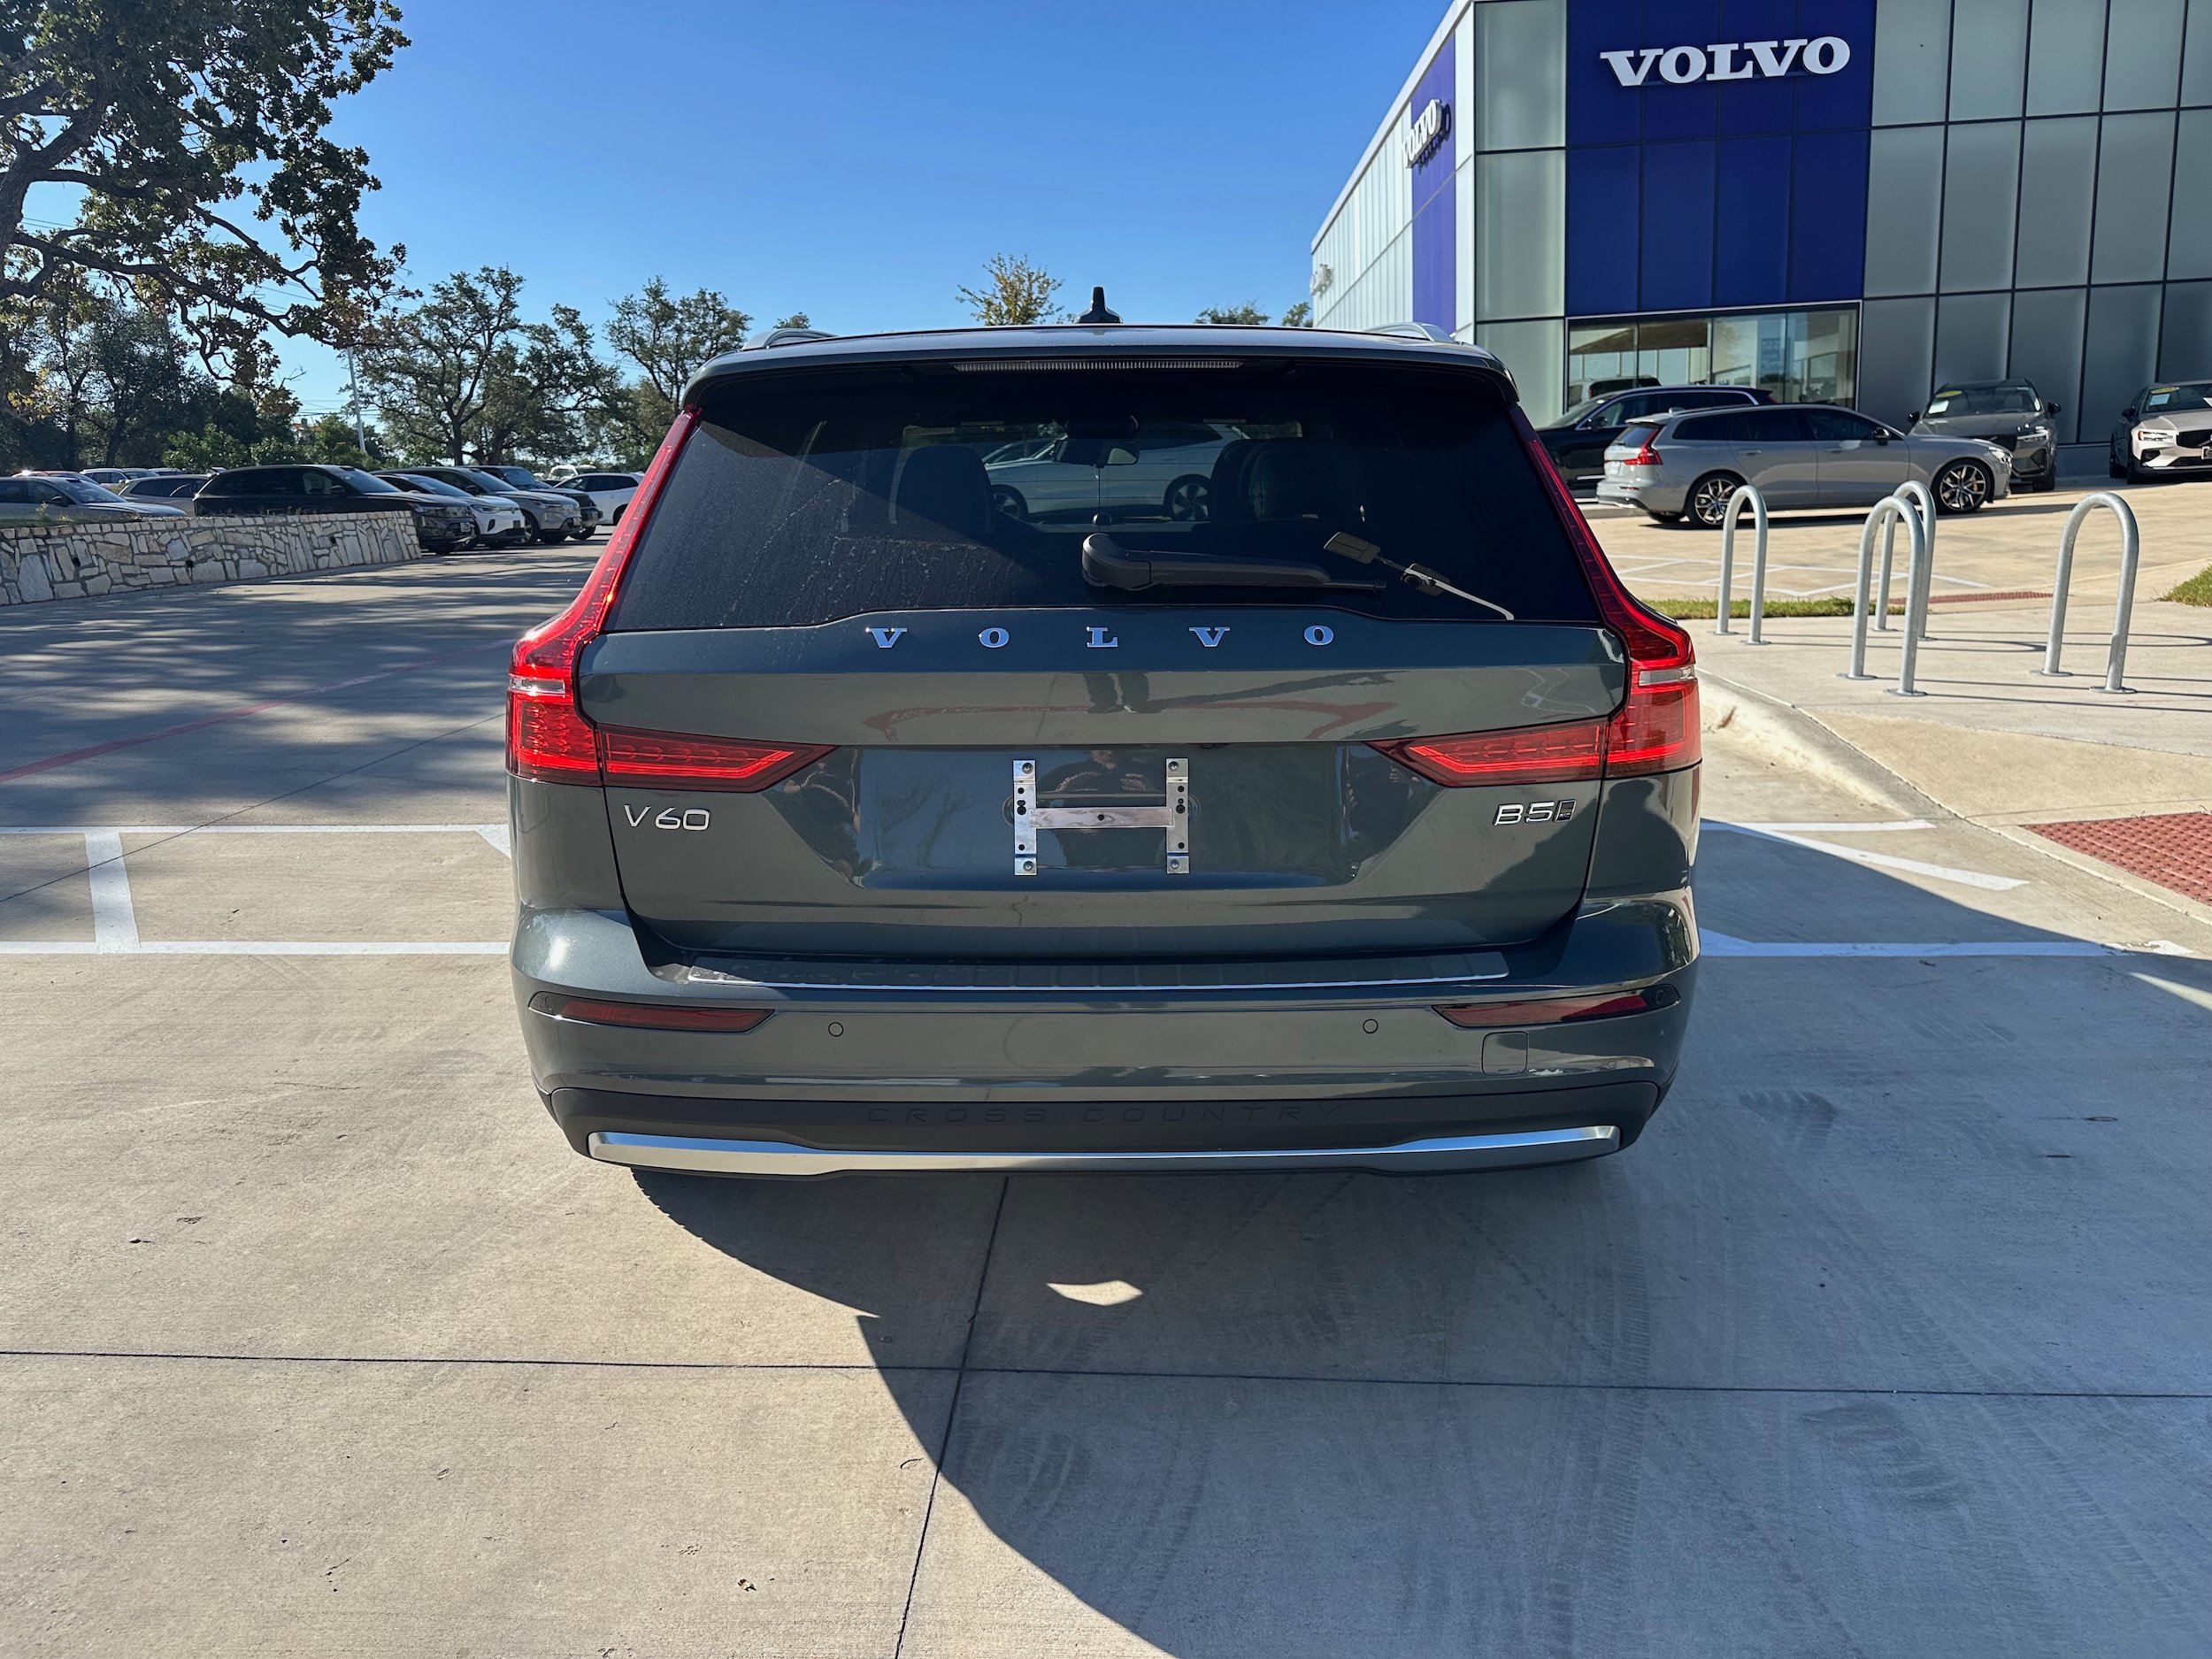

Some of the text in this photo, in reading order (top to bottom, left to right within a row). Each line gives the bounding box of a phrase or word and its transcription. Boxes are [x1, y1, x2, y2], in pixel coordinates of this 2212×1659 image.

[1600, 36, 1850, 86] VOLVO
[1402, 99, 1441, 169] VOLVO
[865, 626, 1334, 649] VOLVO
[624, 804, 710, 830] V60
[1494, 801, 1555, 826] B5
[867, 1104, 1340, 1122] CROSS COUNTRY
